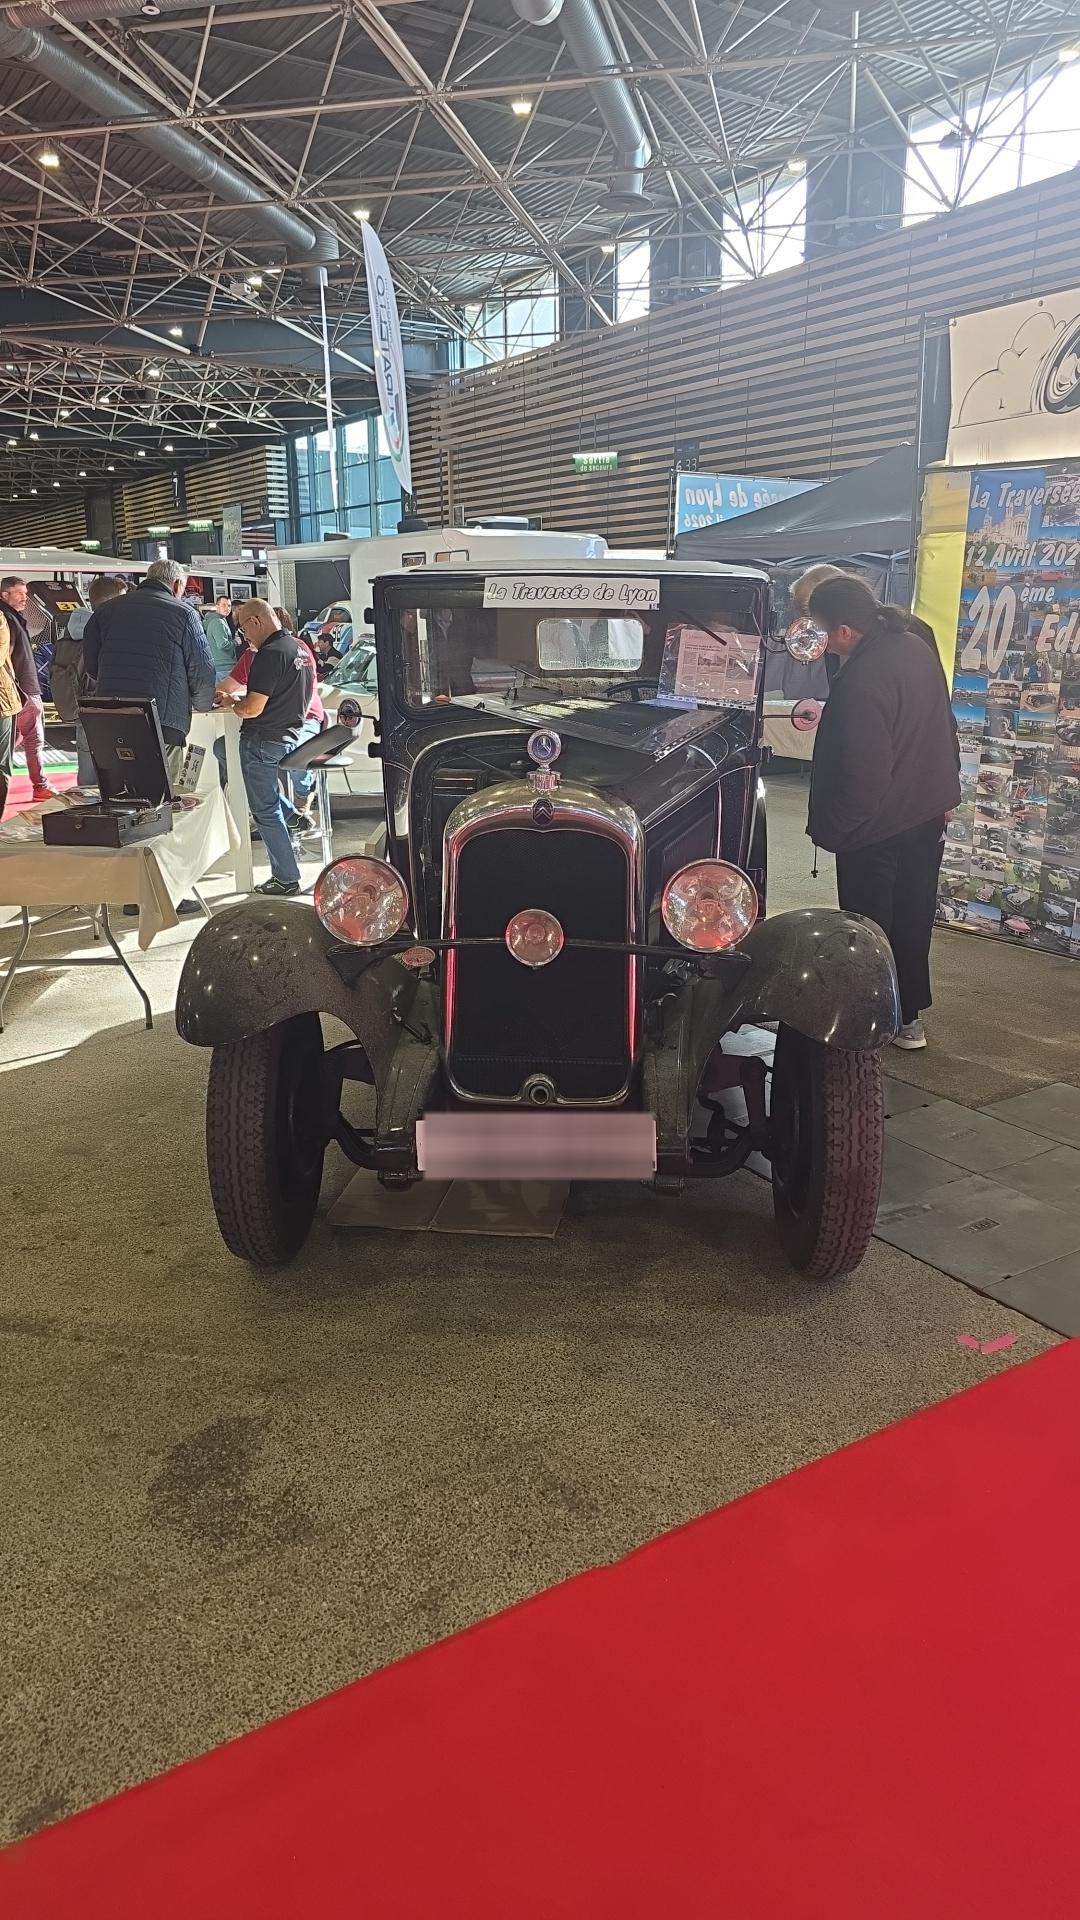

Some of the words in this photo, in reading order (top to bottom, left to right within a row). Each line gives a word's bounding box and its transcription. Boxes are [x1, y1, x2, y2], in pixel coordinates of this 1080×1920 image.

[583, 456, 610, 465] Sortie
[971, 484, 991, 508] La
[965, 545, 988, 567] 12
[989, 541, 1037, 568] Avril
[486, 583, 508, 600] La
[511, 582, 591, 600] Traversée
[592, 582, 615, 600] de
[618, 584, 658, 605] Lyon
[961, 585, 1017, 674] 20
[1020, 582, 1055, 603] ème
